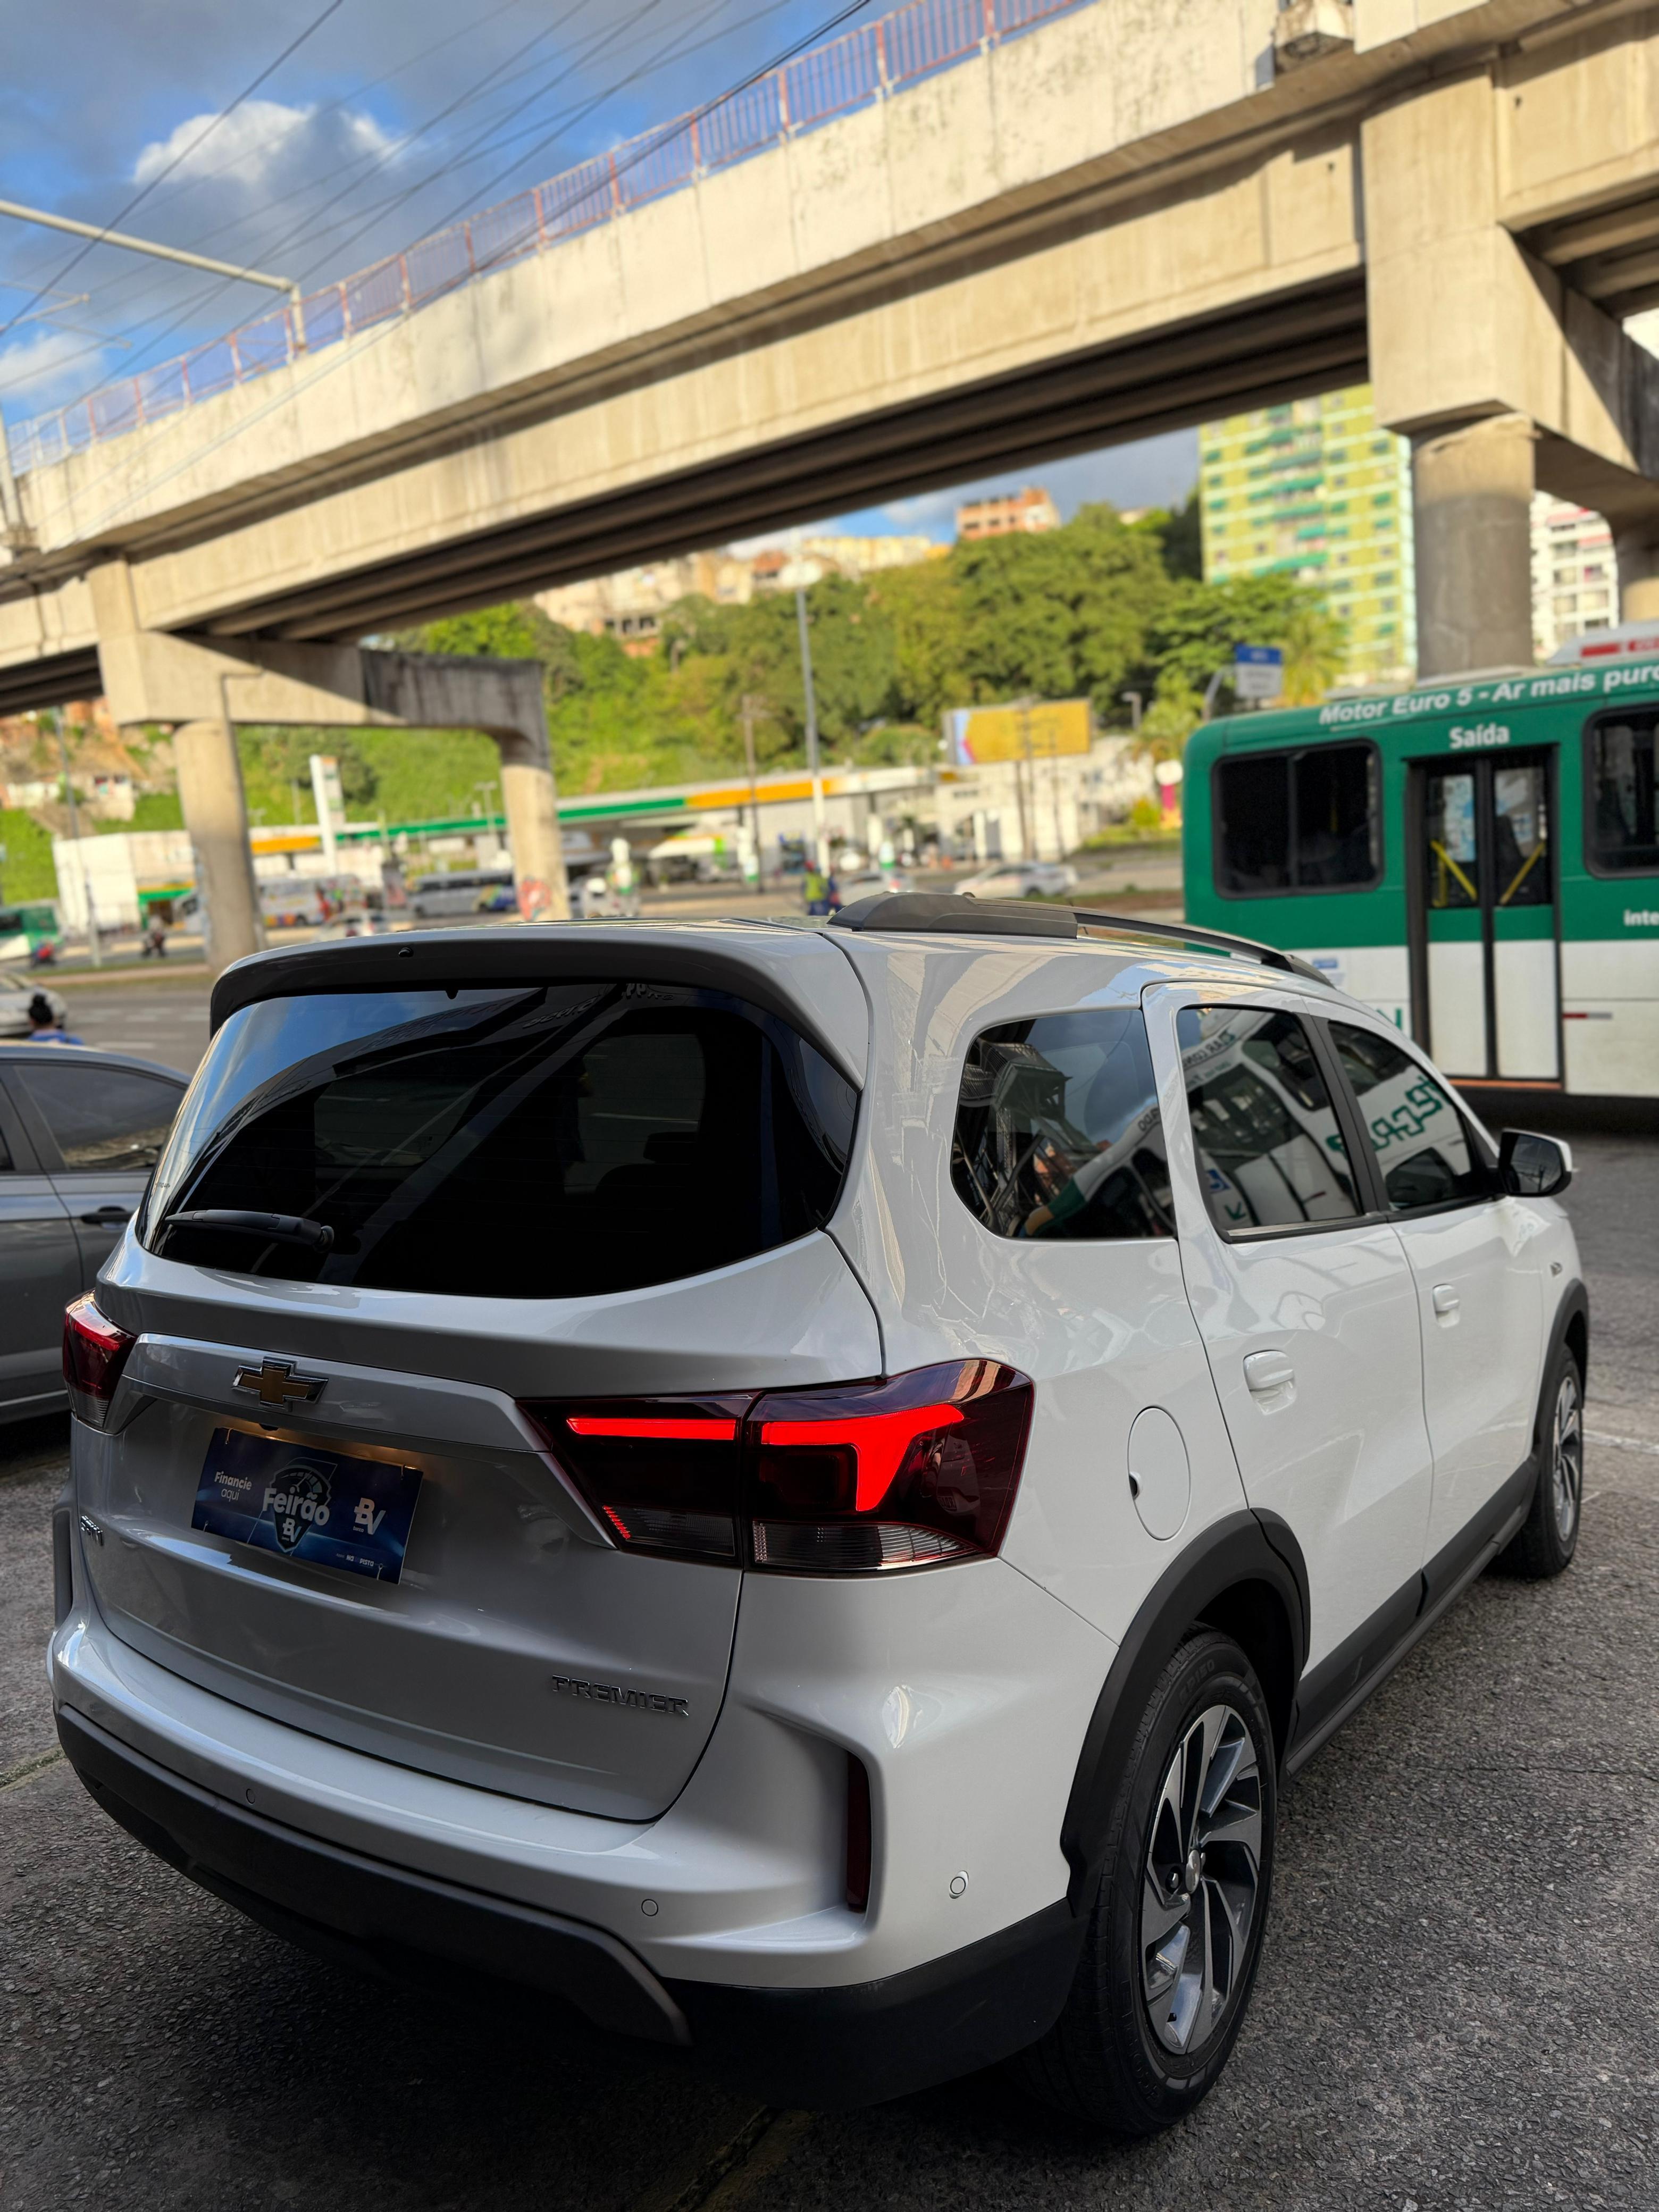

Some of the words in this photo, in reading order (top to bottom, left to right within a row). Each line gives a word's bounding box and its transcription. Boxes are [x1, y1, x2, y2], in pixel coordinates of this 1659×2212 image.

[1319, 701, 1388, 725] Motor
[1392, 692, 1450, 714] Euro
[1456, 688, 1474, 706] 5
[1492, 681, 1524, 702] Ar
[1530, 672, 1596, 696] mais
[1449, 722, 1510, 749] Saída
[214, 1471, 252, 1491] Financie
[263, 1486, 330, 1526] Feirão
[354, 1497, 386, 1535] BV
[282, 1518, 303, 1543] BV
[551, 1675, 689, 1716] PREMIER
